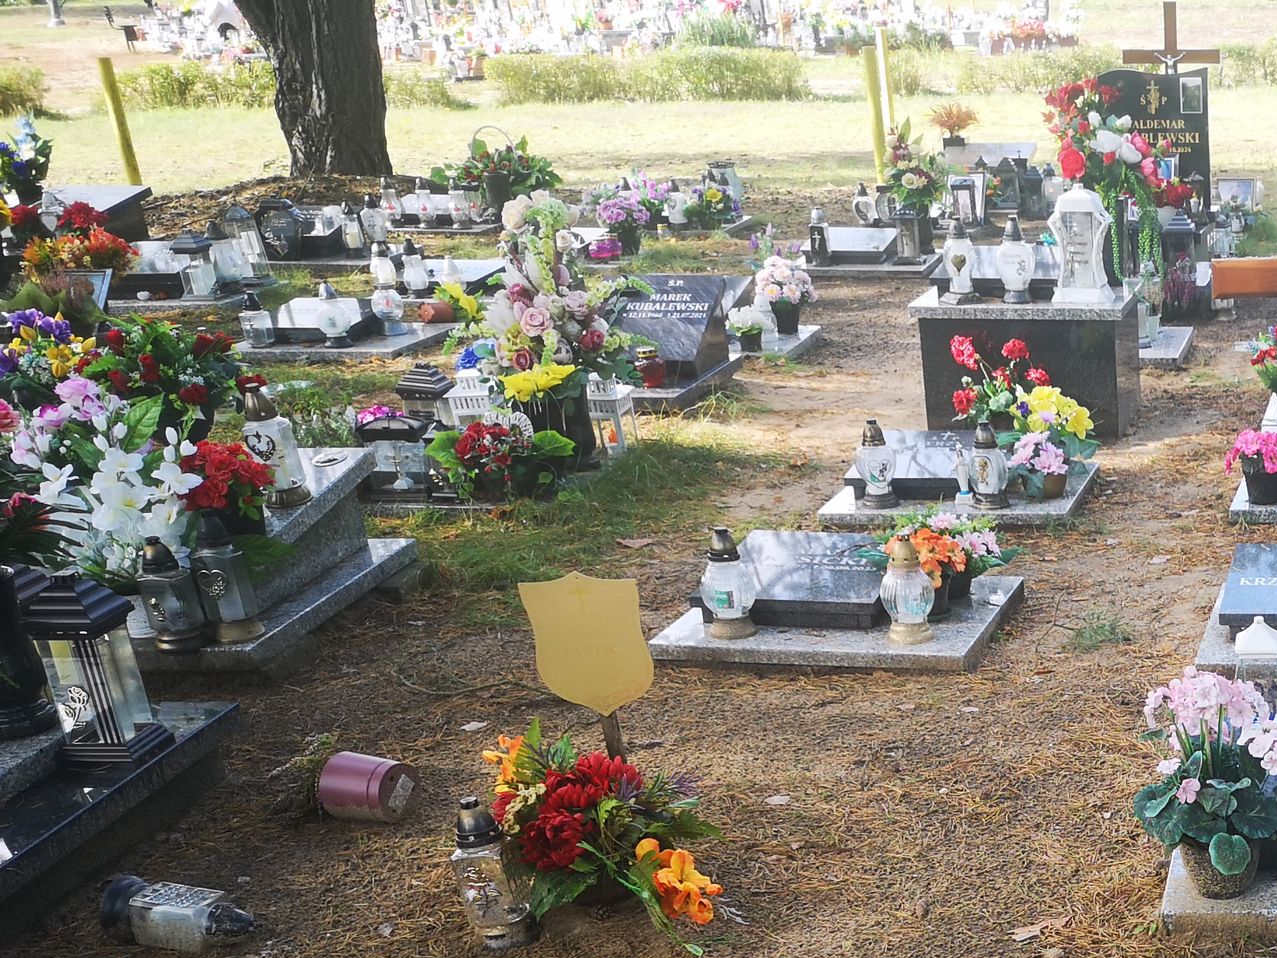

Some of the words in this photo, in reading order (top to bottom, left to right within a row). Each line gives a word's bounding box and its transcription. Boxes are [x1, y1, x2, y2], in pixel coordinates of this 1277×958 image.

[1132, 119, 1186, 129] ALDEMAR
[1141, 132, 1200, 144] BLEWSKI
[649, 293, 692, 302] MAREK
[626, 302, 709, 312] KUBALEWSKI
